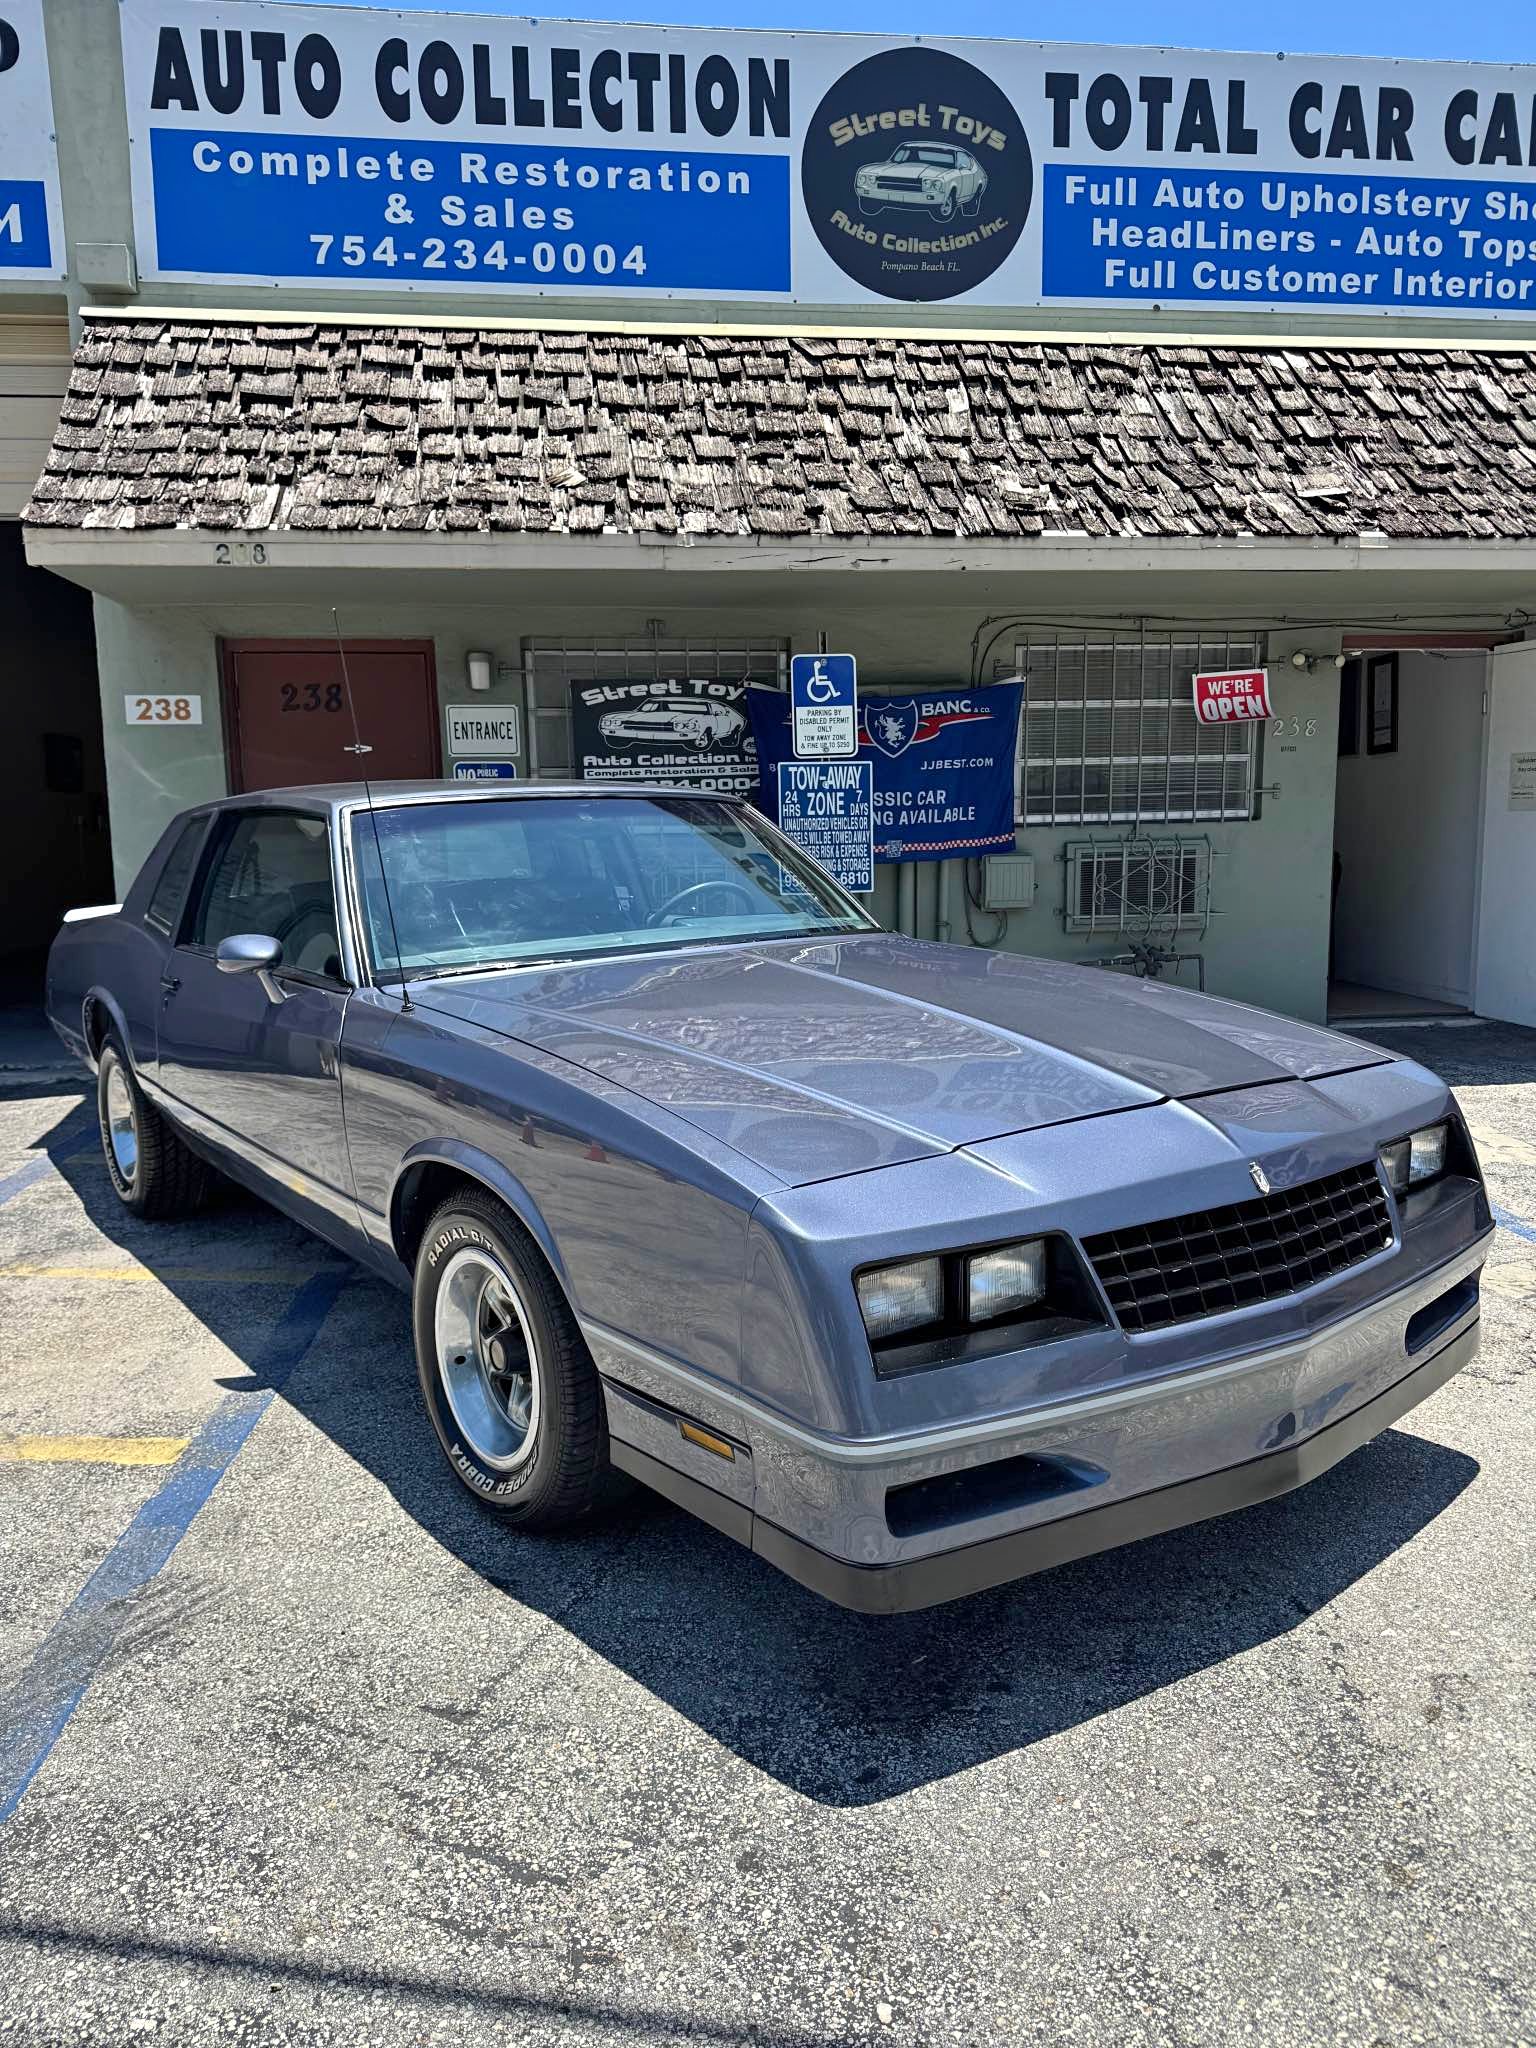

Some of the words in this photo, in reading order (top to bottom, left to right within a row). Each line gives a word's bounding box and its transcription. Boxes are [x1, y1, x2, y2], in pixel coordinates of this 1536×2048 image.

[151, 27, 341, 119] AUTO
[375, 38, 790, 137] COLLECTION
[829, 103, 931, 147] Street
[938, 105, 1007, 151] Toys
[1045, 72, 1258, 154] TOTAL
[1289, 82, 1414, 161] CAR
[1445, 89, 1536, 166] CA
[192, 141, 434, 184] Complete
[461, 153, 750, 194] Restoration
[1065, 175, 1137, 206] Full
[1153, 178, 1244, 209] Auto
[1261, 182, 1471, 225] Upholstery
[1484, 191, 1536, 221] Sh
[384, 193, 415, 224] &
[441, 195, 575, 230] Sales
[830, 210, 877, 245] Auto
[882, 230, 980, 253] Collection
[982, 217, 1008, 238] Inc.
[1092, 218, 1316, 252] HeadLiners
[1355, 226, 1443, 256] Auto
[310, 234, 647, 275] 754-234-0004
[881, 261, 918, 272] Pompano
[921, 261, 945, 271] Beach
[1105, 259, 1176, 289] Full
[1192, 261, 1379, 294] Customer
[1393, 268, 1534, 300] Interior
[216, 543, 266, 564] 28
[281, 683, 342, 712] 238
[581, 679, 683, 706] Street
[689, 679, 747, 700] Toy
[1208, 679, 1254, 695] WE'RE
[136, 698, 191, 720] 238
[922, 700, 971, 716] BANC
[1202, 695, 1266, 720] OPEN
[454, 722, 513, 740] ENTRANCE
[800, 717, 827, 725] DISABLED
[1273, 715, 1317, 736] 238
[583, 755, 632, 767] Auto
[637, 753, 740, 767] Collection
[744, 755, 758, 763] In
[920, 758, 993, 770] JJBEST.COM
[457, 769, 476, 779] NO
[477, 768, 499, 777] PUBLIC
[586, 769, 641, 777] Complete
[644, 767, 715, 777] Restoration
[718, 766, 727, 774] &
[730, 766, 758, 774] Sale
[788, 766, 862, 790] TOW-AWAY
[785, 791, 797, 803] 24
[807, 792, 844, 815] ZONE
[856, 790, 863, 802] 7
[873, 791, 912, 806] SSIC
[917, 790, 946, 805] CAR
[783, 804, 801, 816] HRS
[850, 803, 869, 815] DAYS
[899, 806, 975, 825] AVAILABLE
[784, 818, 829, 831] UNAUTHORIZED
[830, 817, 858, 830] VEHICLES
[859, 817, 868, 829] OR
[809, 832, 823, 844] WILL
[824, 831, 832, 844] BE
[832, 831, 853, 843] TOWED
[853, 831, 870, 843] AWAY
[821, 845, 834, 858] RISK
[836, 845, 841, 857] &
[841, 844, 868, 857] EXPENSE
[838, 859, 842, 871] &
[842, 858, 870, 871] STORAGE
[428, 1227, 469, 1267] RADIAL
[451, 1442, 495, 1492] COBRA
[496, 1445, 538, 1495] COOPER
